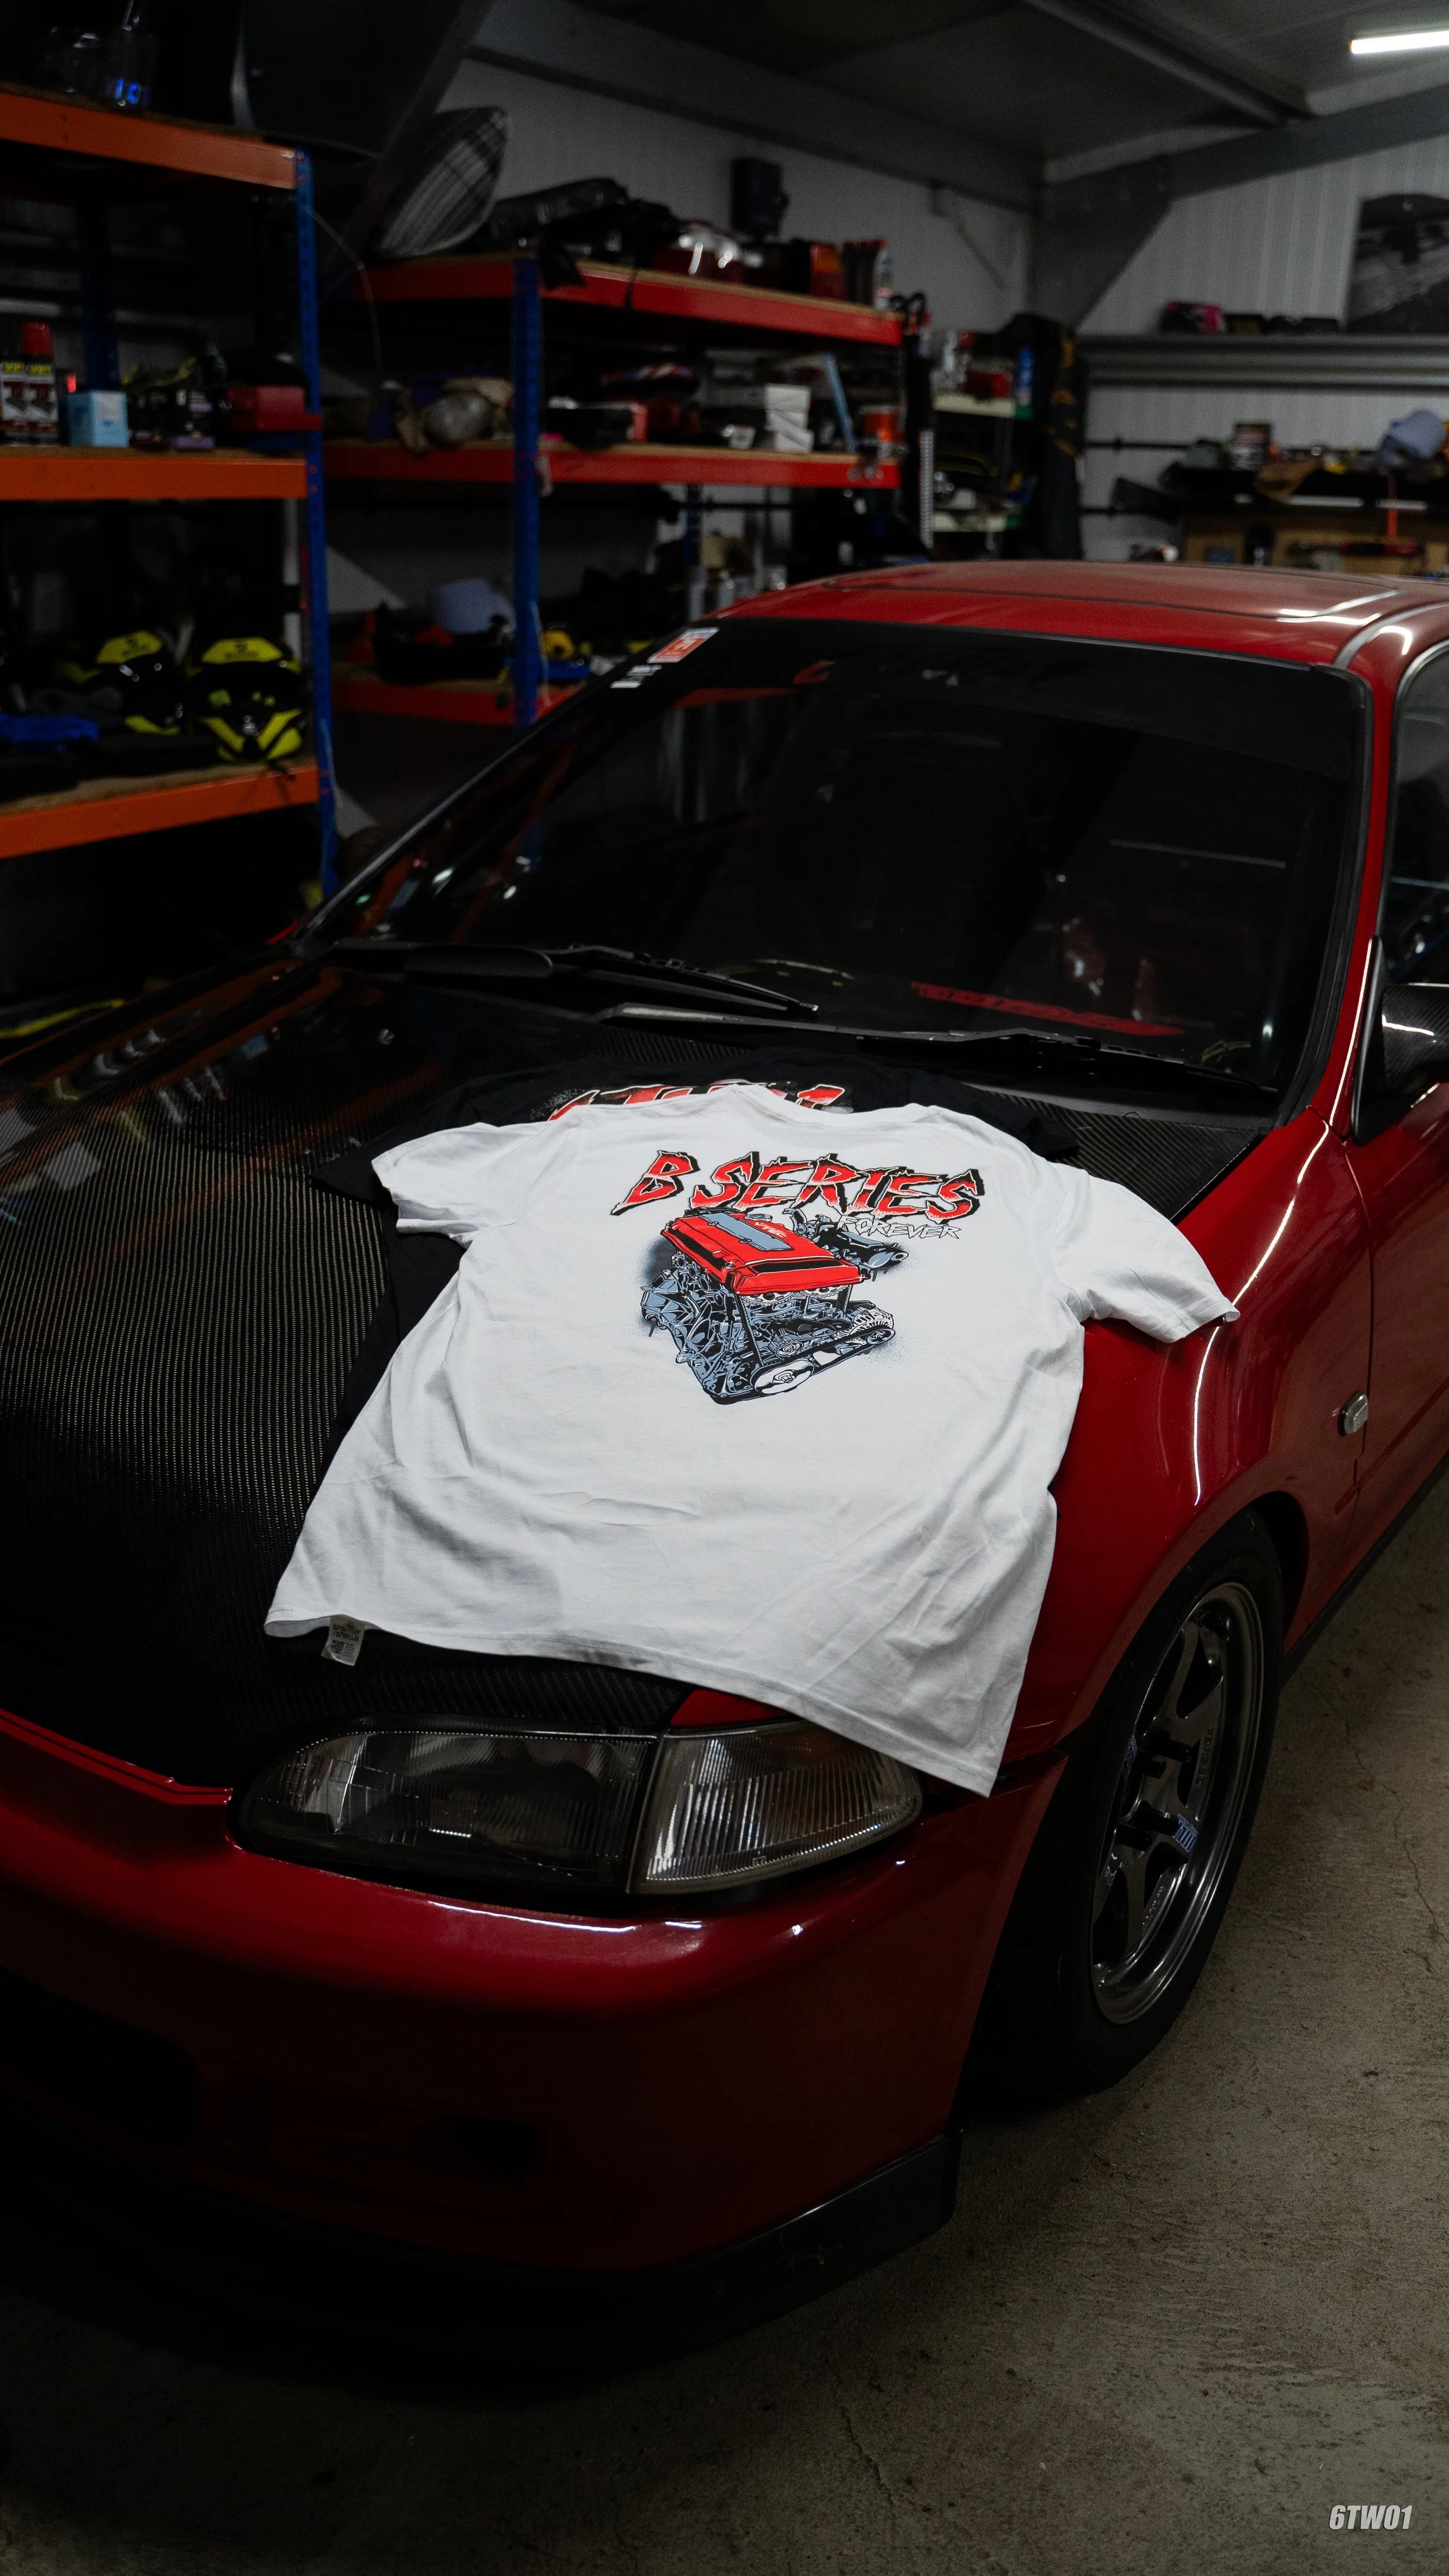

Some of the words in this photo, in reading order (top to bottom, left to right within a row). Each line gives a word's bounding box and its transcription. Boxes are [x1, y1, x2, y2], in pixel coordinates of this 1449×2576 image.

[610, 1150, 701, 1215] B
[689, 1151, 985, 1224] SERIES
[837, 1215, 962, 1239] FOREVER
